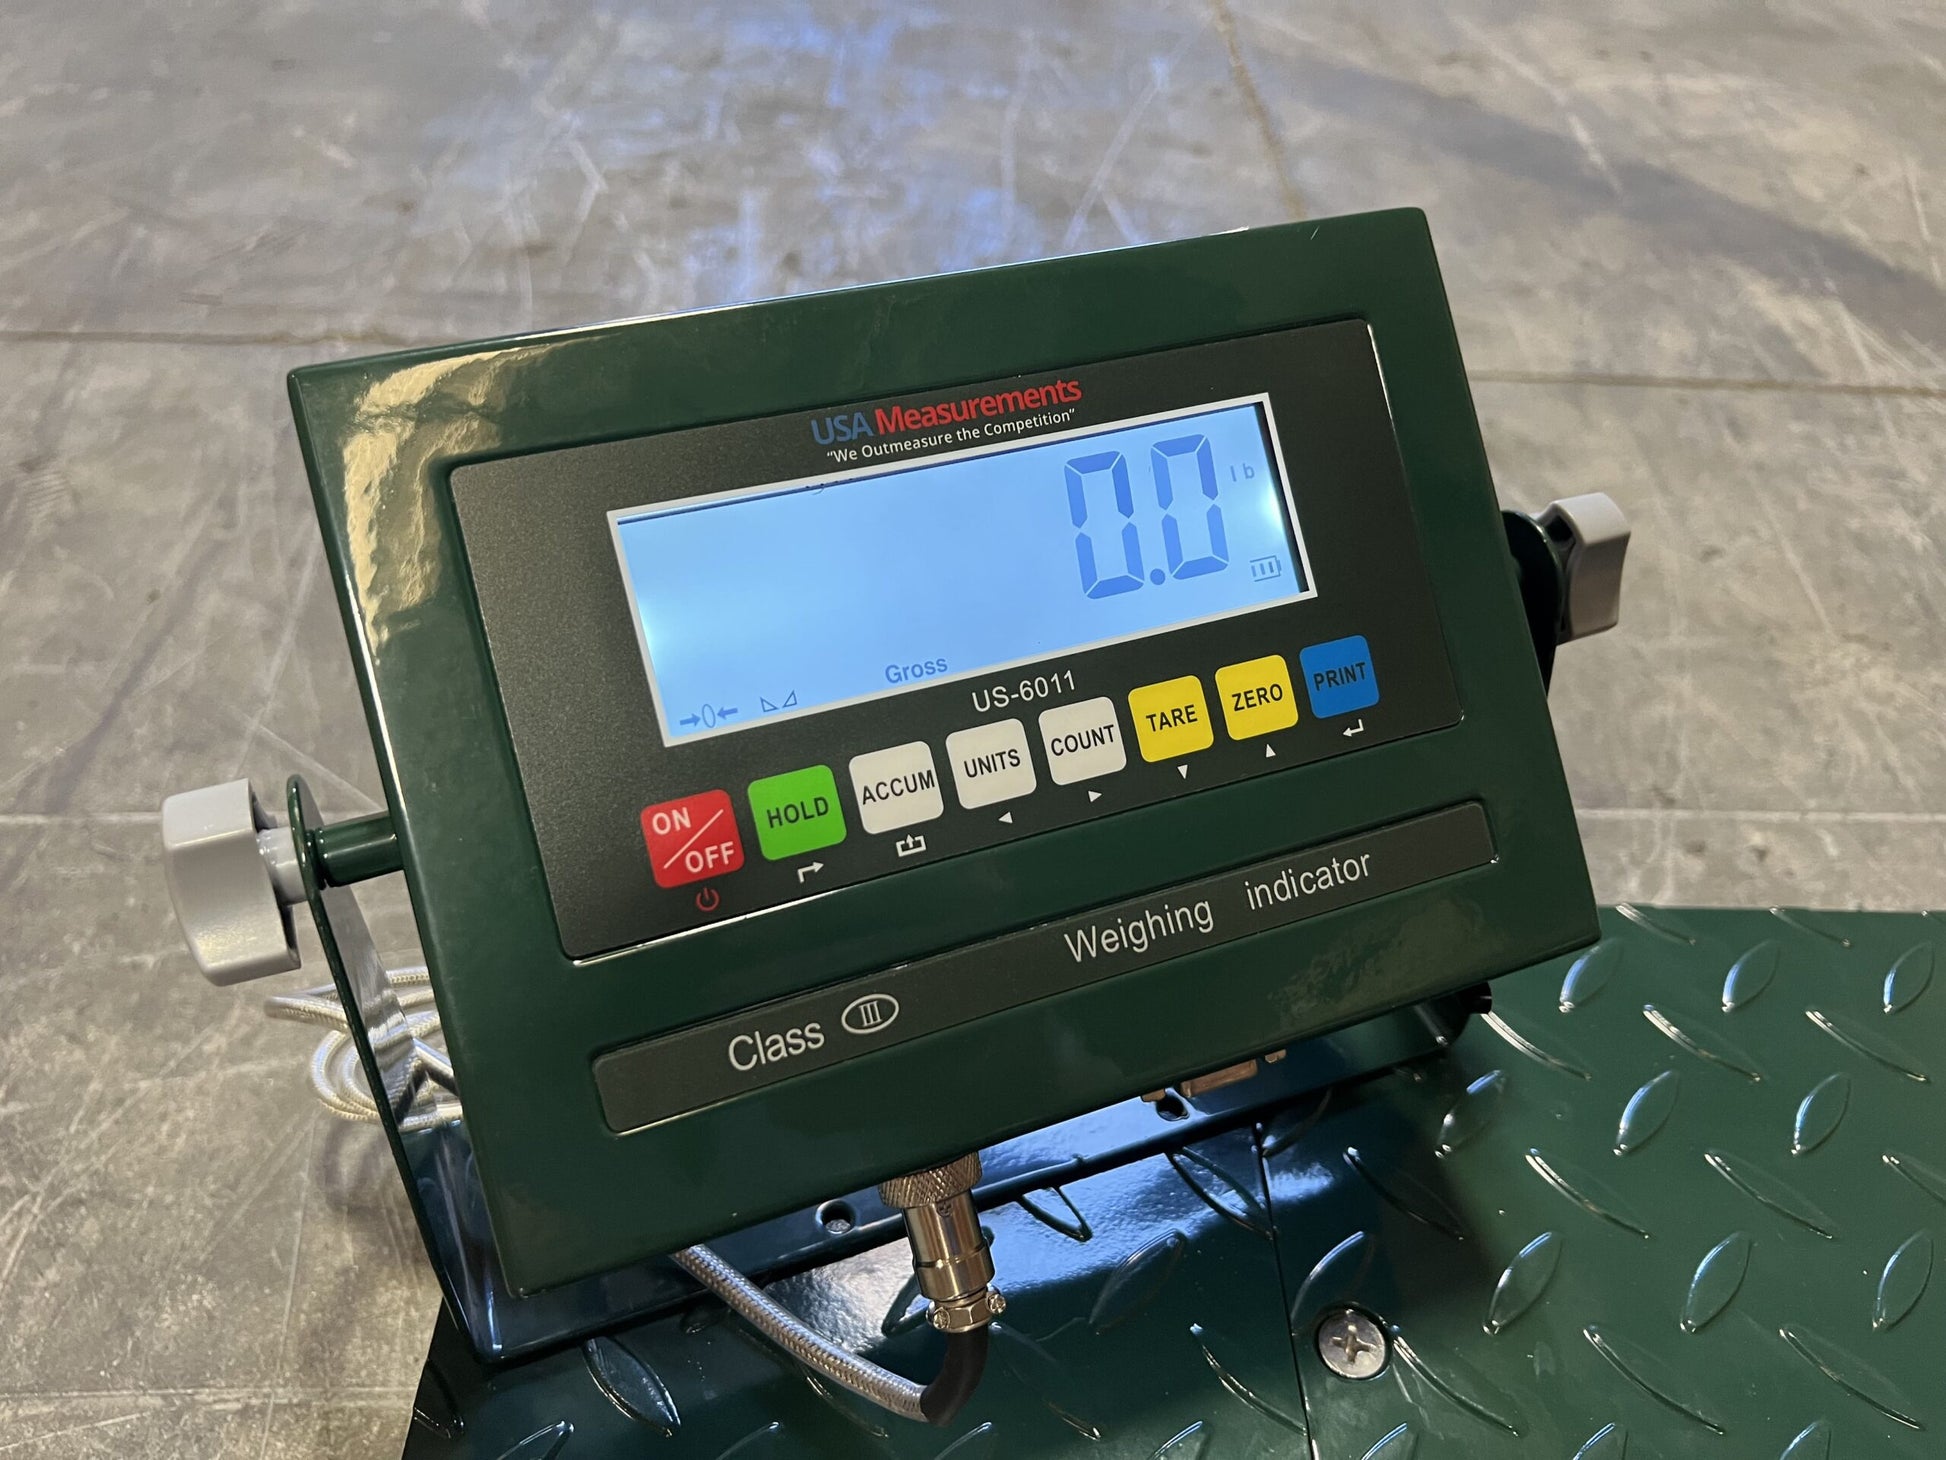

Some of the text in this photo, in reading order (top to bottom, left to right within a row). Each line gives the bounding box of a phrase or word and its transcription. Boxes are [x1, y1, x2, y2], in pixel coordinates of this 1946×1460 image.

[811, 379, 1082, 445] USA Measurements
[862, 431, 953, 458] Outmeasure
[957, 425, 980, 442] the
[1064, 433, 1229, 599] 0.0
[884, 658, 948, 684] Gross
[1313, 661, 1367, 692] PRINT
[972, 669, 1076, 712] US-6011
[1231, 683, 1284, 712] ZERO
[1146, 704, 1198, 733] TARE
[1050, 724, 1115, 757] COUNT
[963, 748, 1021, 778] UNITS
[862, 769, 935, 805] ACCUM
[652, 807, 691, 835] ON
[766, 796, 829, 829] HOLD
[685, 841, 734, 873] OFF
[1064, 851, 1371, 963] Weighing indicator
[727, 1020, 825, 1072] Class
